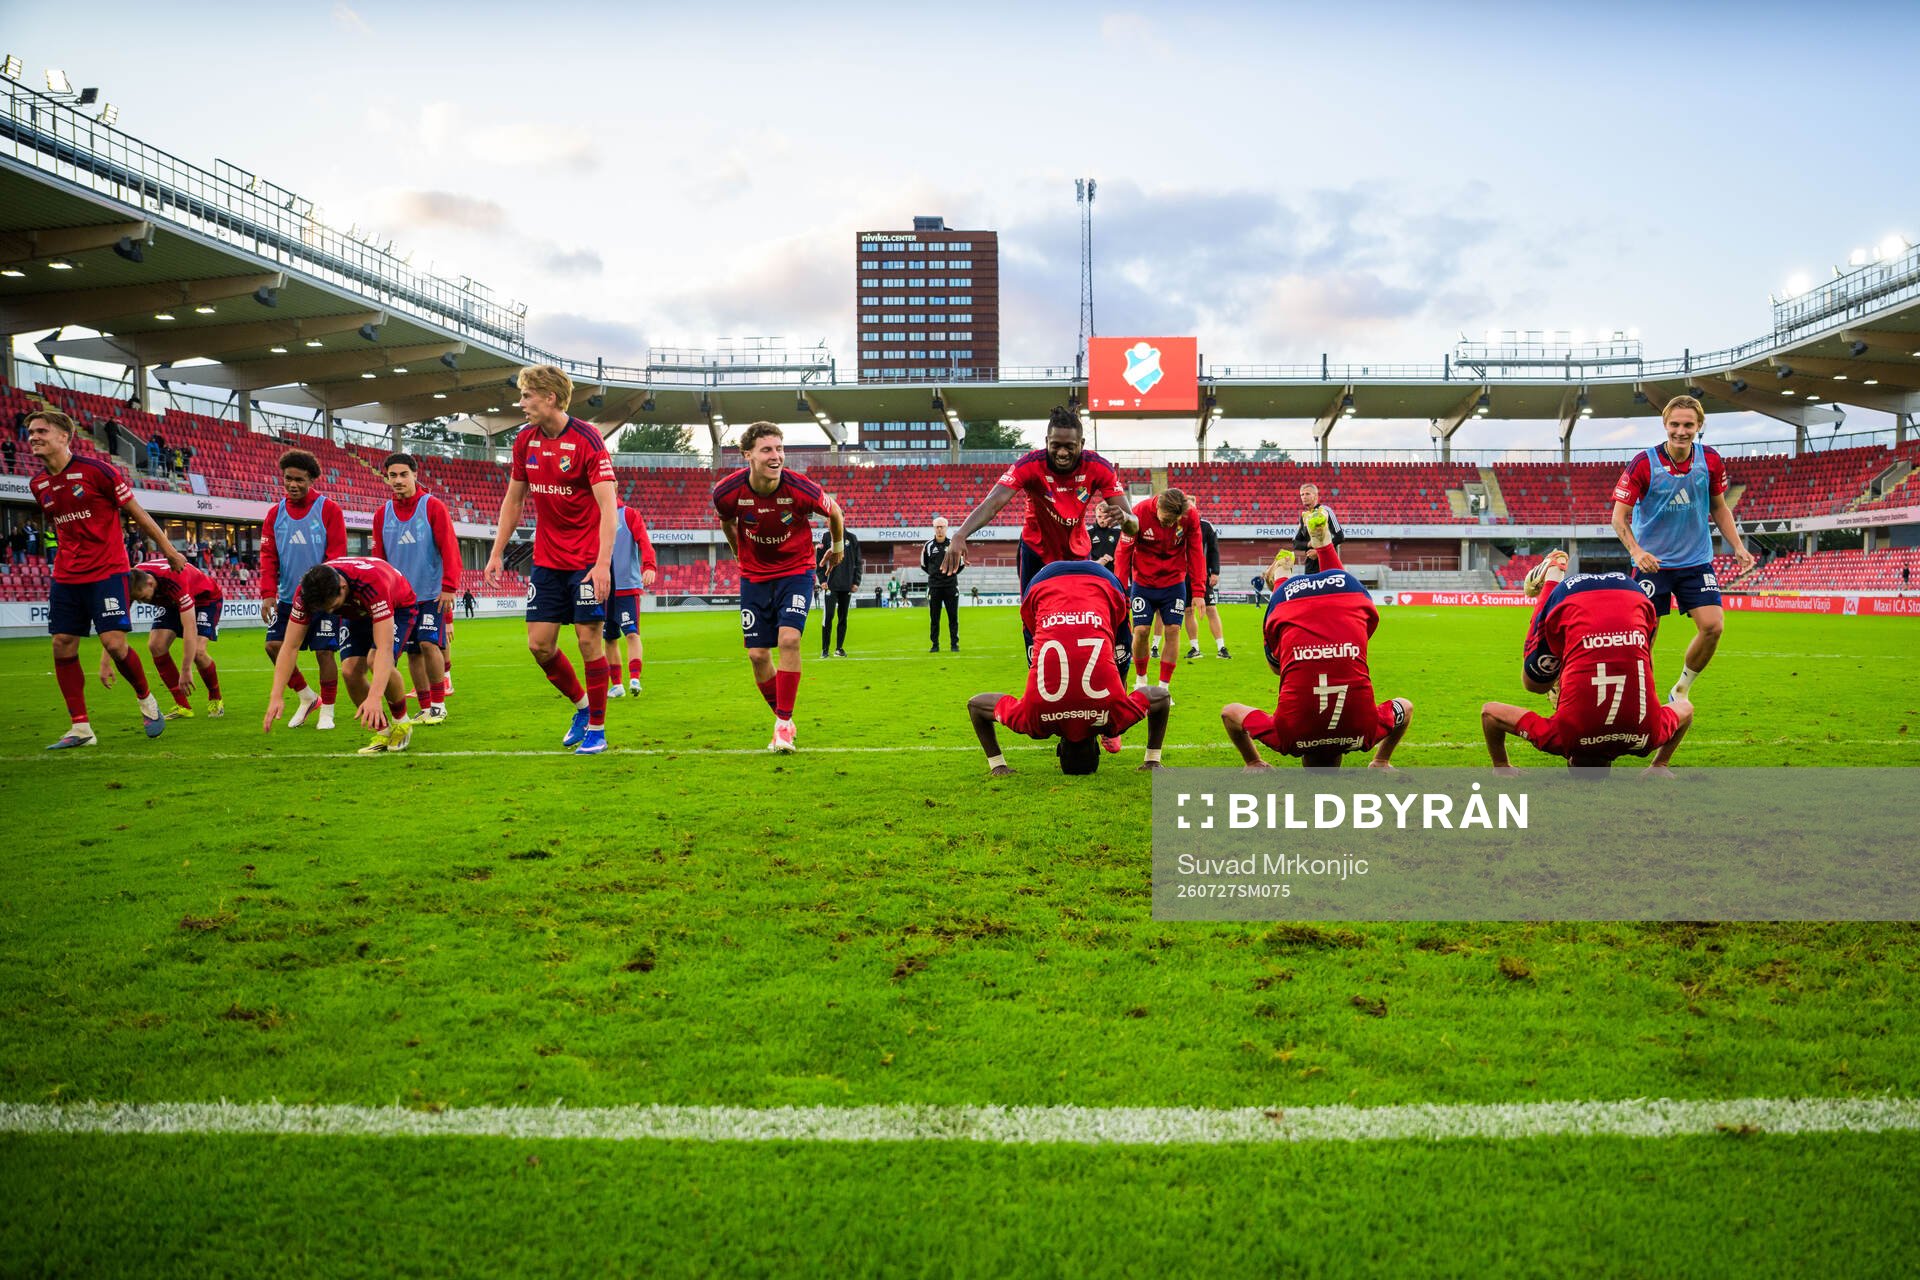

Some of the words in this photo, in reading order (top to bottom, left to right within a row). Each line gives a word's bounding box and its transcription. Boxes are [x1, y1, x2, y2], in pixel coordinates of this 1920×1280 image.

[652, 533, 694, 541] PREMON
[879, 530, 920, 538] PREMON
[1285, 574, 1346, 601] GoAhead
[1432, 594, 1458, 604] Maxi
[1460, 594, 1479, 604] ICA
[1750, 596, 1763, 608] Maxi
[1764, 596, 1774, 608] ICA
[1873, 599, 1892, 612] Maxi
[1892, 599, 1906, 613] ICA
[102, 610, 126, 618] BALCO
[223, 602, 262, 617] PREMON
[1041, 611, 1103, 629] dynacon
[1582, 630, 1647, 649] dynacon
[1293, 642, 1360, 660] dynacon
[1037, 638, 1110, 702] 20
[1591, 660, 1648, 725] 14
[1313, 674, 1349, 730] 4
[1041, 709, 1109, 725] Fellessons
[1296, 735, 1364, 749] Fellessons
[1580, 732, 1649, 749] Fellessons
